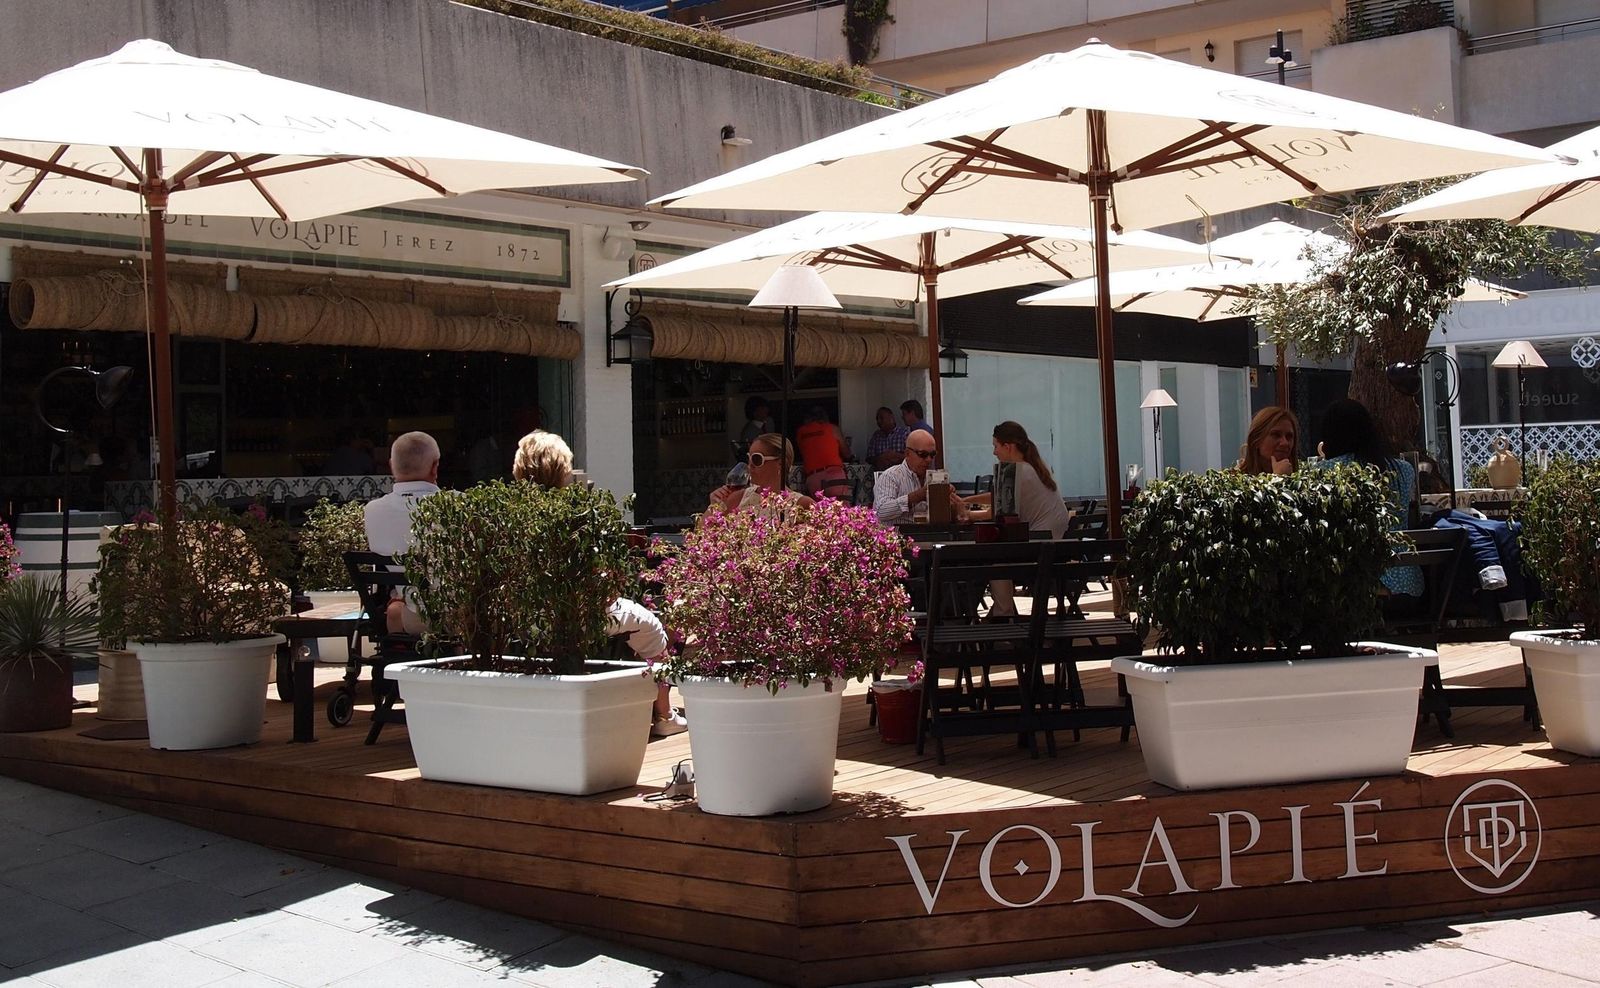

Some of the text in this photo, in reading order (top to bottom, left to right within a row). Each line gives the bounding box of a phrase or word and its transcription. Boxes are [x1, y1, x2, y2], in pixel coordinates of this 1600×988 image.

[250, 217, 360, 250] VOLAPIÉ
[382, 230, 454, 251] JEREZ
[497, 243, 541, 261] 1872
[884, 781, 1388, 929] VOLAPIÉ
